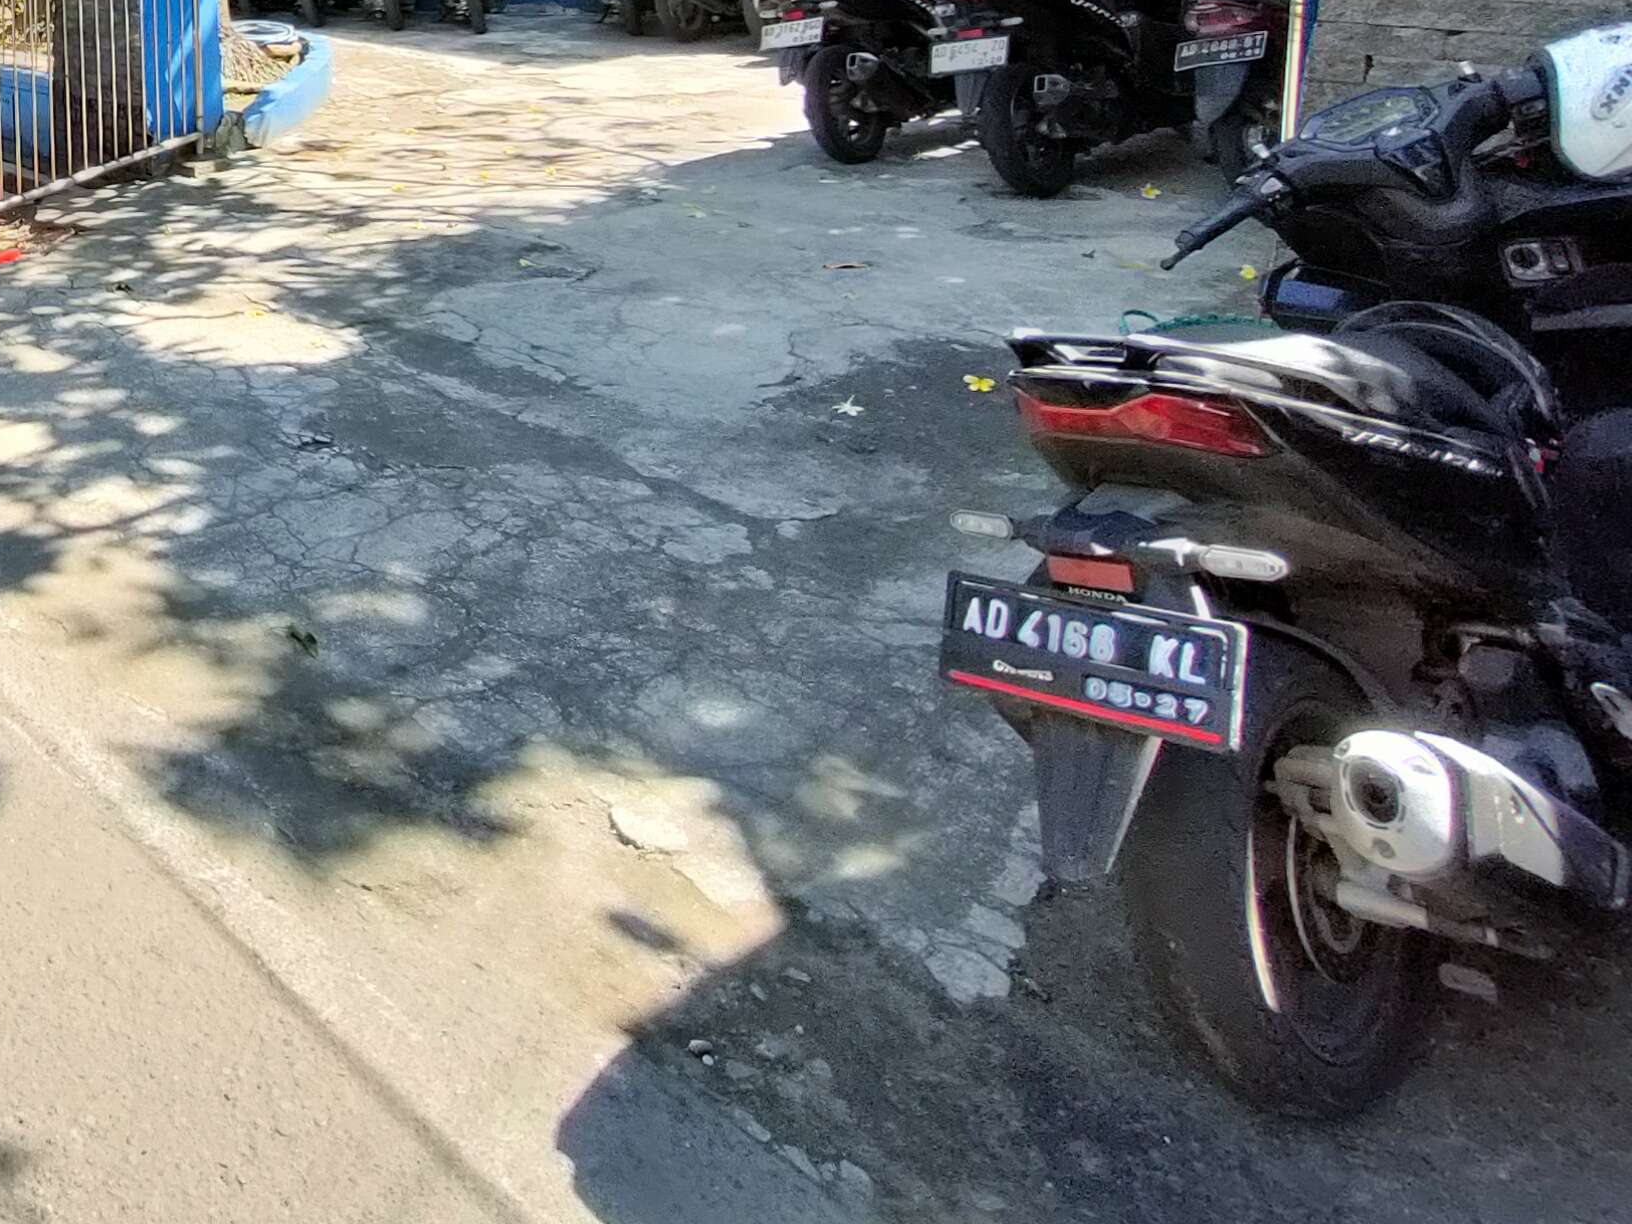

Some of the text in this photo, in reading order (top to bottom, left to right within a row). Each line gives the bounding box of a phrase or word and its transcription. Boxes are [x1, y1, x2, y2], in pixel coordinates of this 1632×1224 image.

[1068, 586, 1128, 603] HONDA
[962, 596, 1009, 640] AD
[1148, 633, 1207, 686] KL
